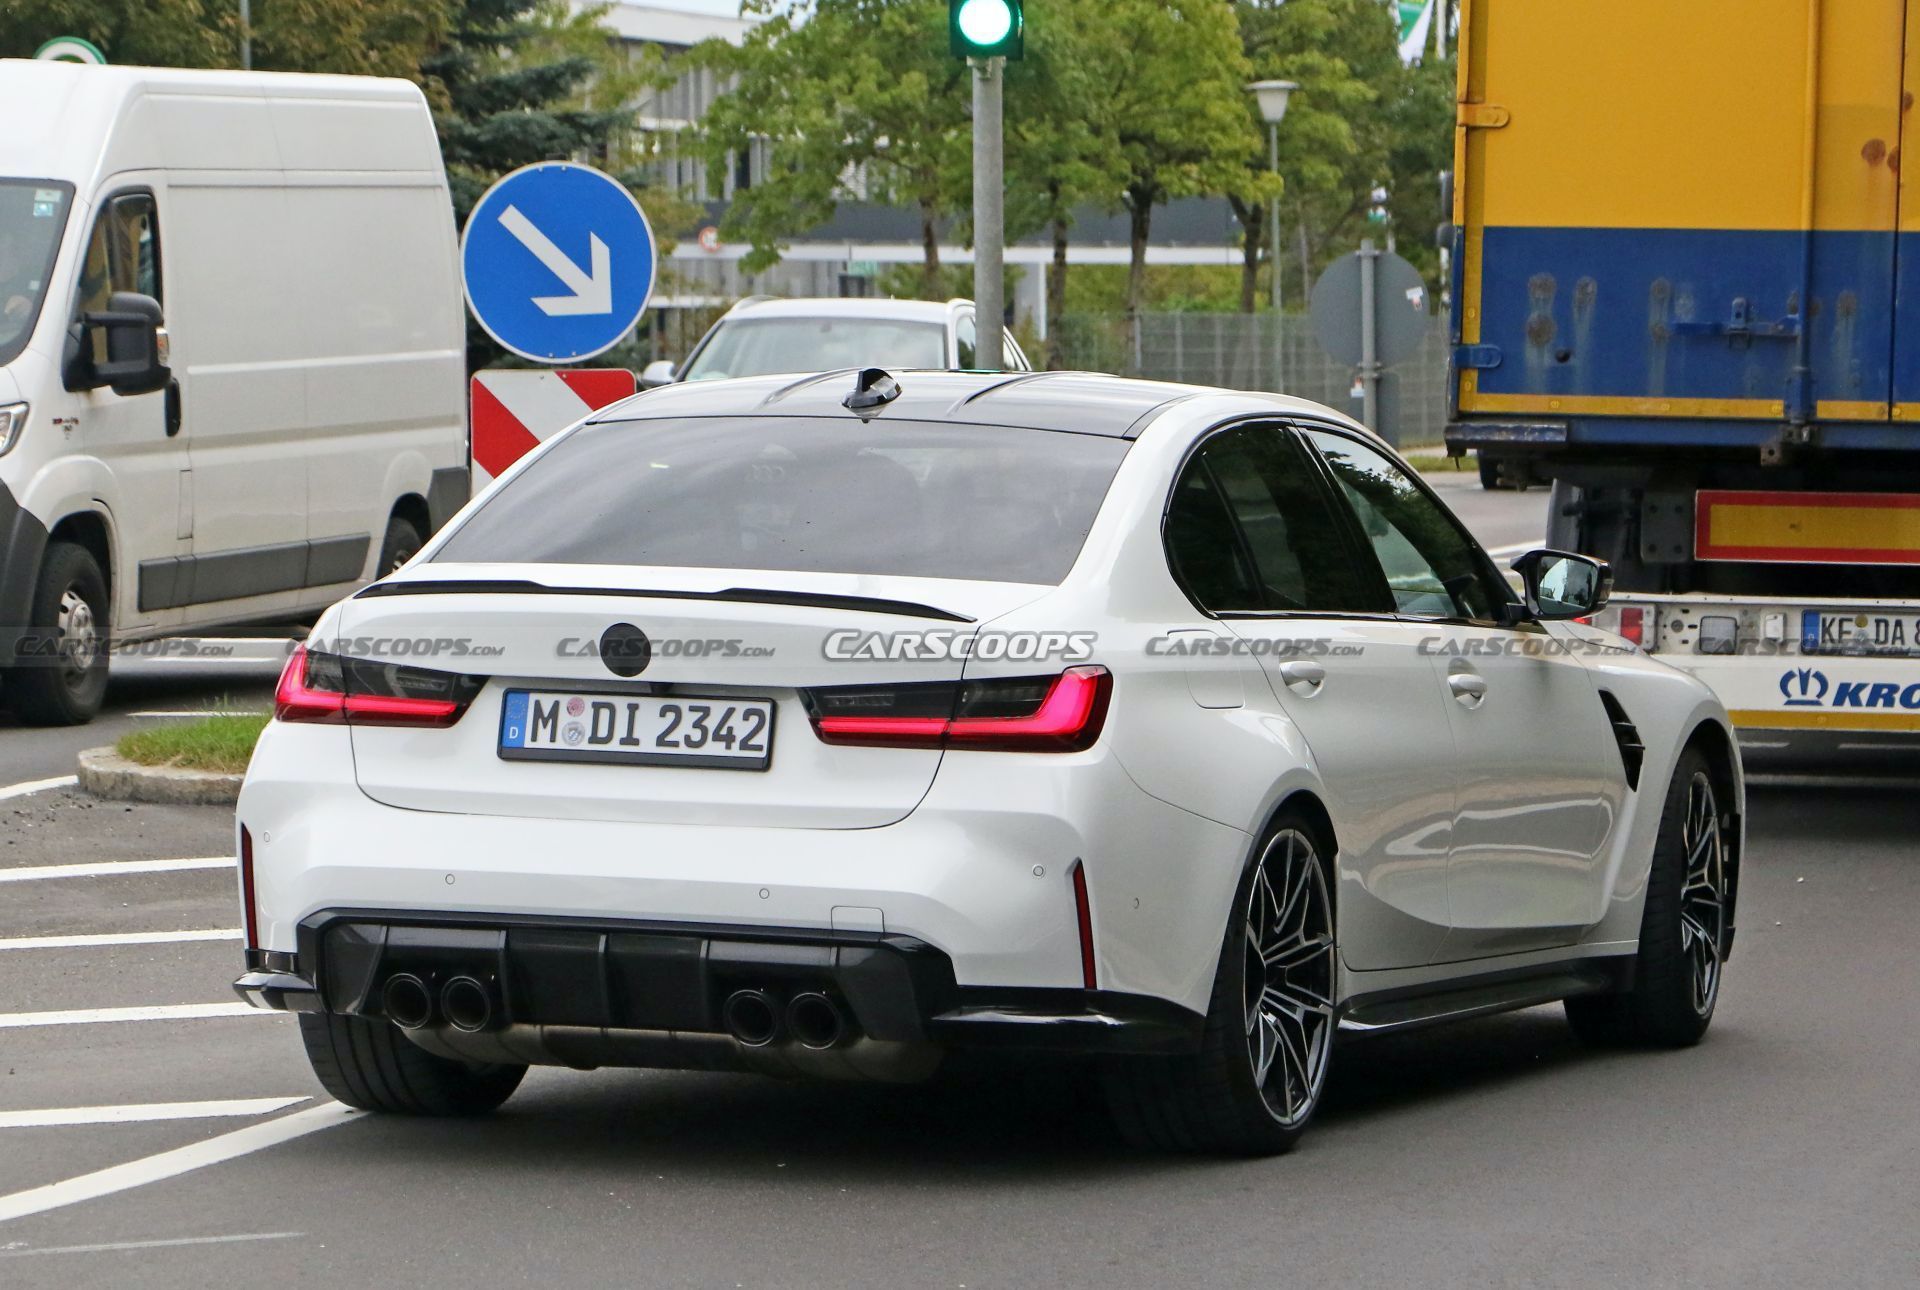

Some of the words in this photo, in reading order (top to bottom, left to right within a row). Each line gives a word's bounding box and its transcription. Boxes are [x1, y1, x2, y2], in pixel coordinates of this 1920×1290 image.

[1874, 618, 1906, 646] DA
[508, 726, 519, 739] D
[530, 699, 560, 743] M
[587, 701, 640, 746] DI
[655, 704, 767, 752] 2342
